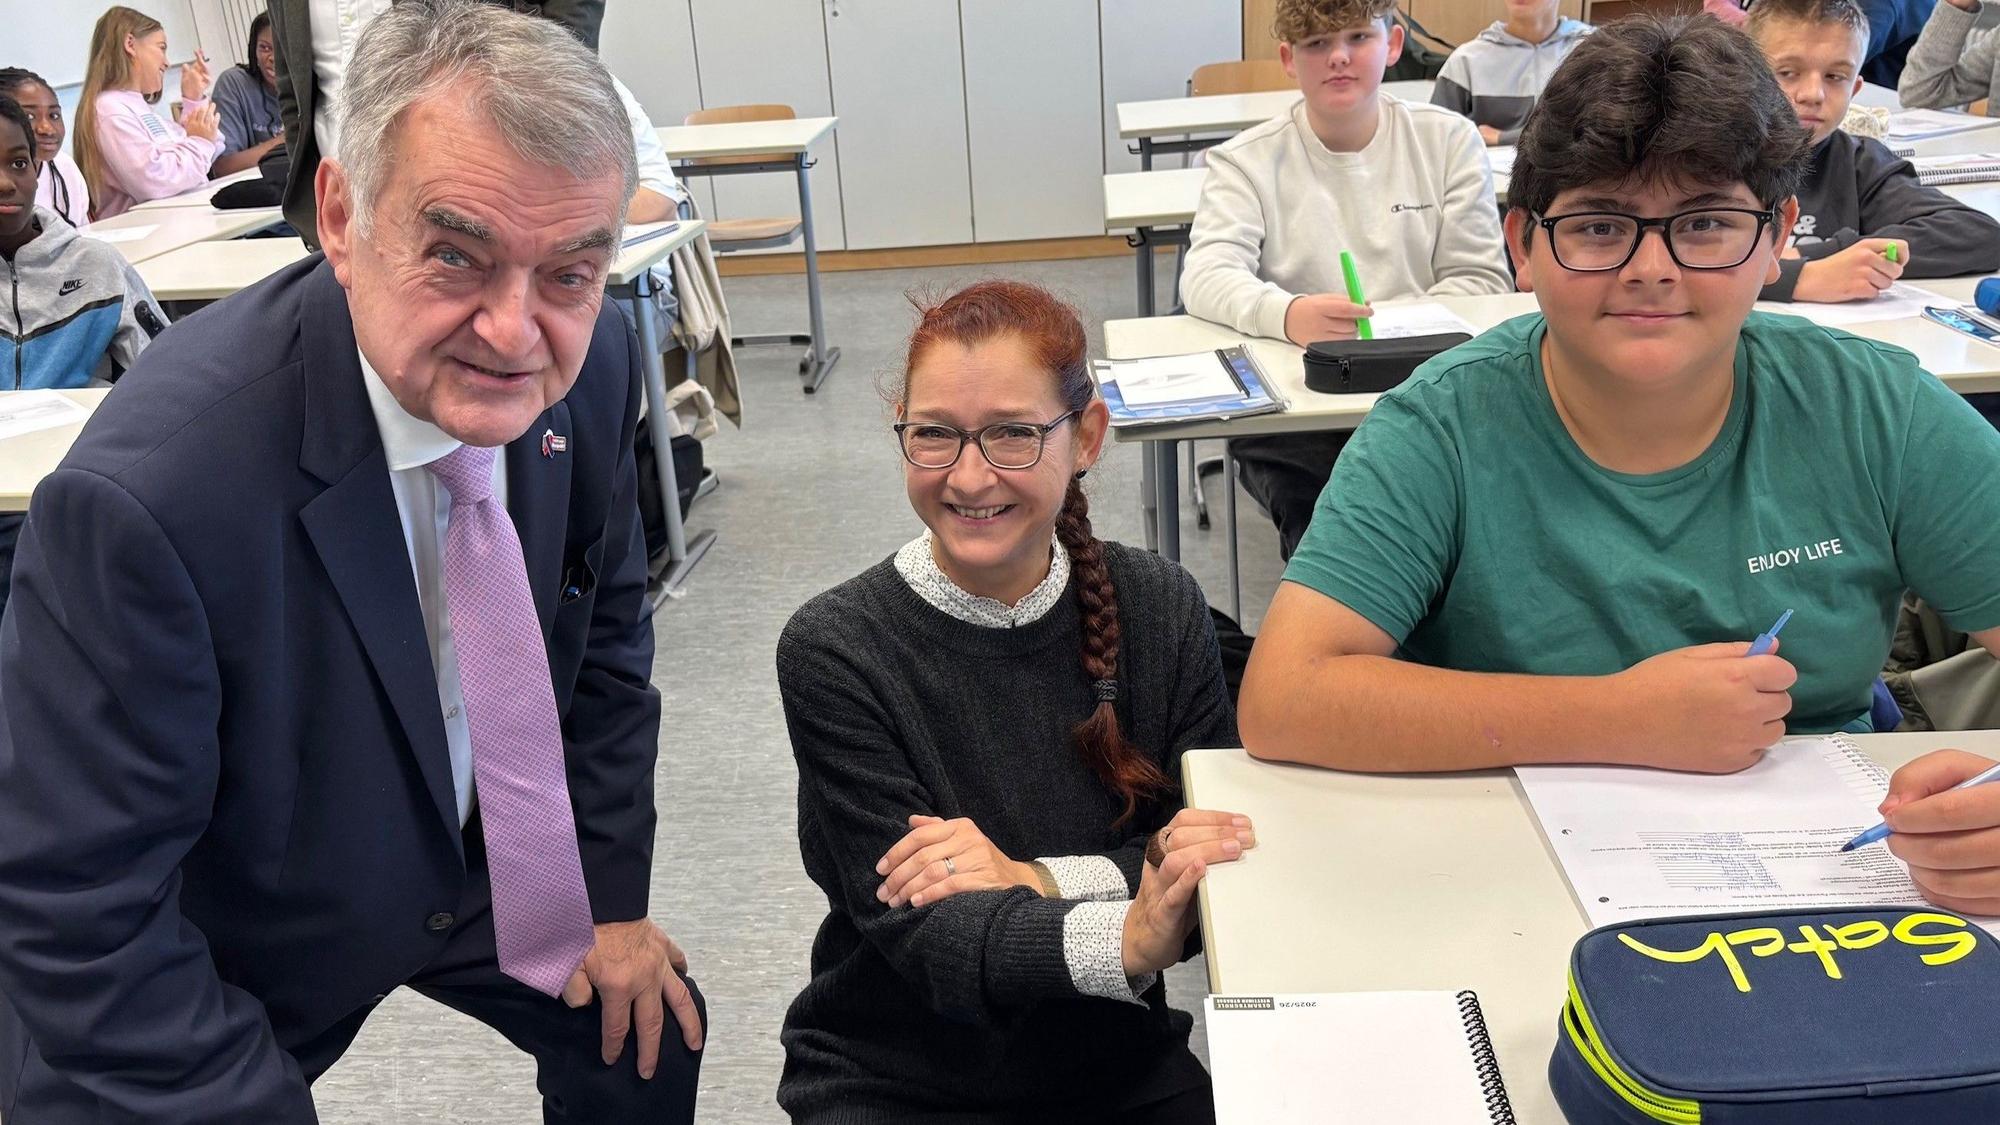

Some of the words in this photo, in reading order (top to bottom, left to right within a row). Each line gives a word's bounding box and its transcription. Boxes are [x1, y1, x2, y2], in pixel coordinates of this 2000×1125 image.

[62, 278, 84, 290] NIKE
[1747, 547, 1800, 574] ENJOY
[1804, 538, 1843, 561] LIFE
